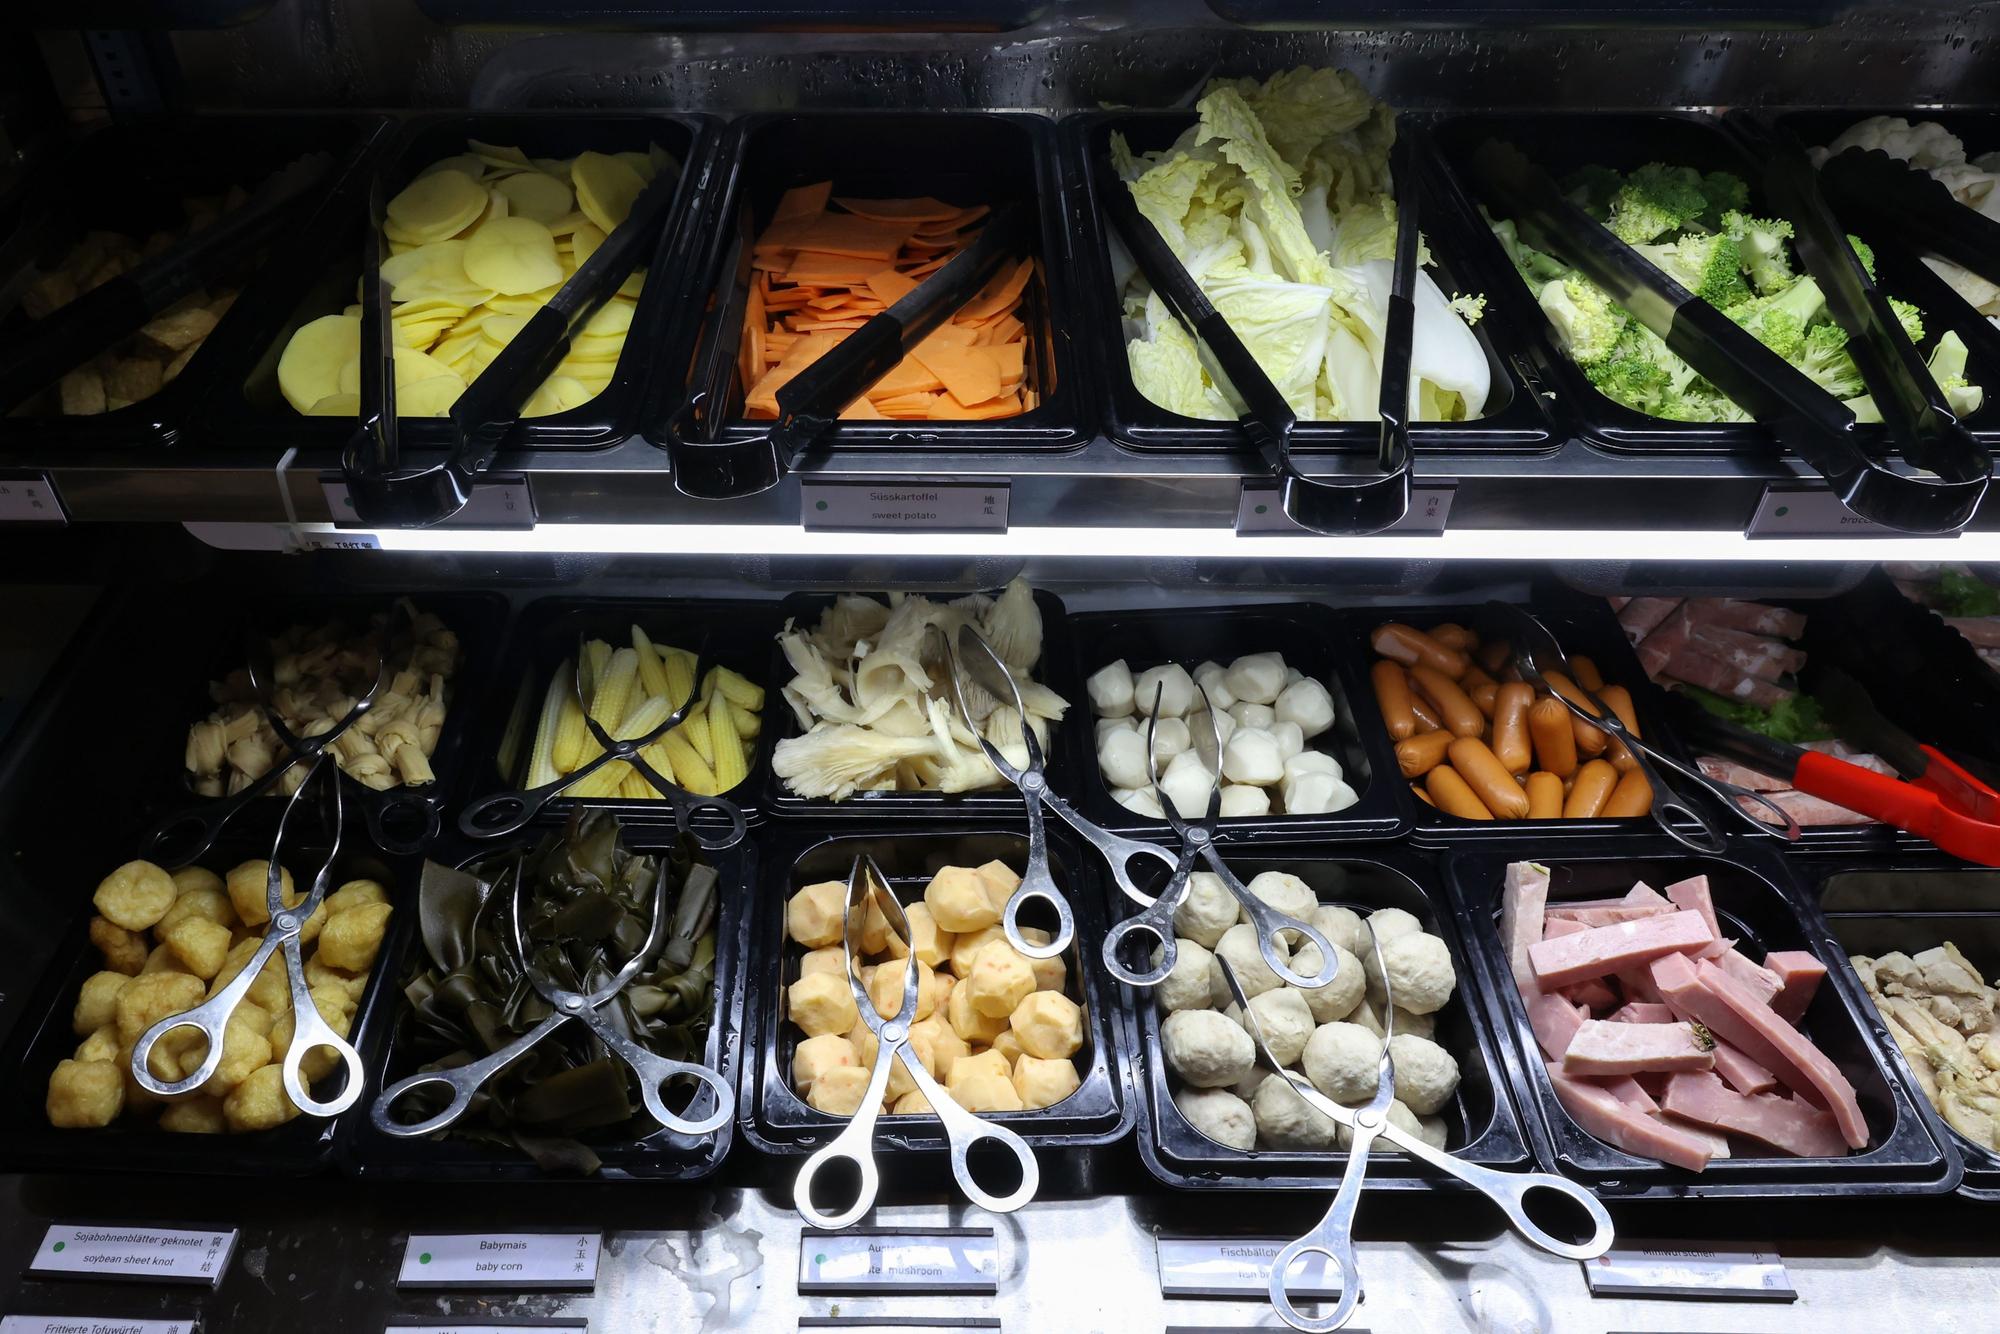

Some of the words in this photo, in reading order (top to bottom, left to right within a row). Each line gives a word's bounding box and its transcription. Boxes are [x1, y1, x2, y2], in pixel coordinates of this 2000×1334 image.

[870, 492, 938, 502] Süsskartoffel
[872, 511, 901, 520] sweet
[904, 511, 937, 521] potato
[74, 1231, 160, 1246] Sojabohnenblätter
[161, 1236, 202, 1248] geknotet
[480, 1240, 527, 1251] Babymais
[83, 1254, 121, 1266] soybean
[124, 1256, 150, 1266] sheet
[152, 1257, 174, 1266] knot
[476, 1261, 499, 1272] baby
[501, 1262, 523, 1271] corn
[888, 1266, 943, 1277] mushroom
[45, 1324, 88, 1334] Frittierte
[92, 1325, 143, 1334] Tofuwürfel
